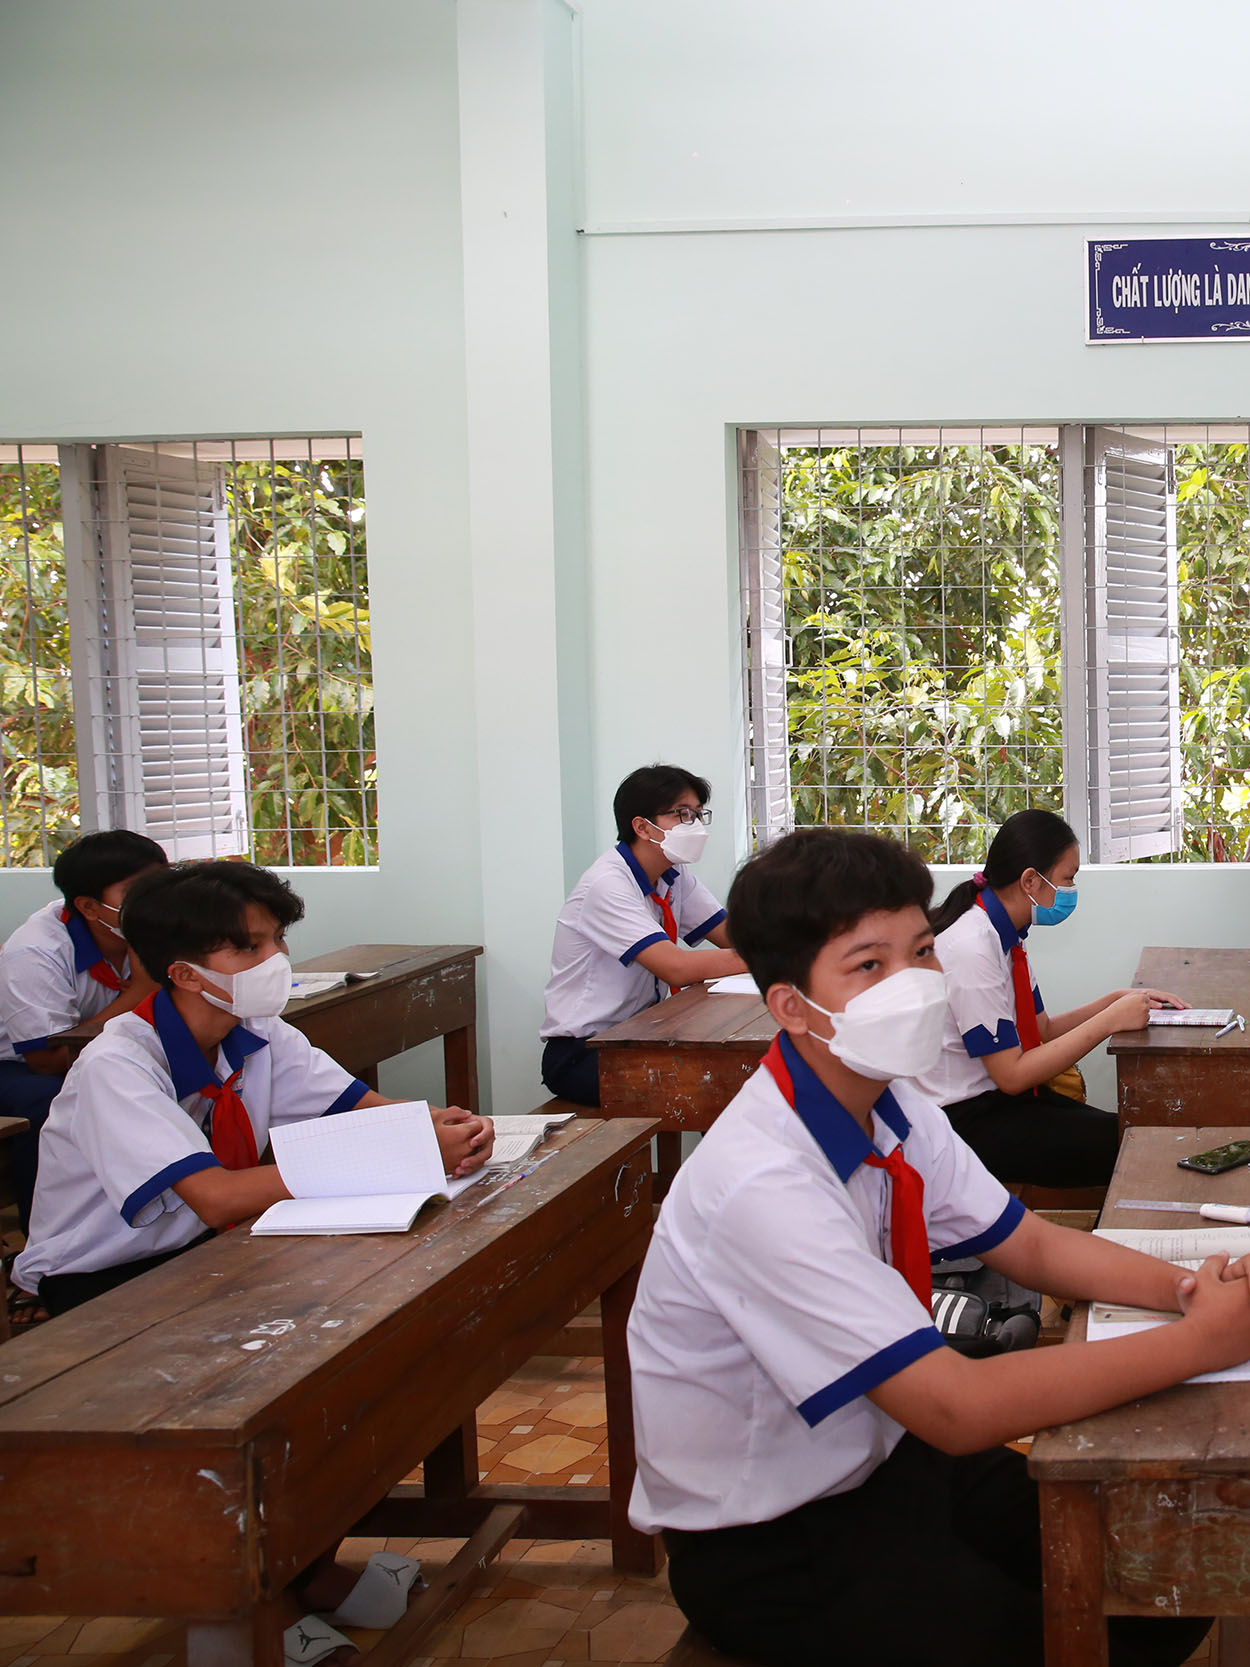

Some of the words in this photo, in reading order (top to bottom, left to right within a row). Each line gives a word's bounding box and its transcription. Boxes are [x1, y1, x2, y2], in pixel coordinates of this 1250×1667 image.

[1112, 262, 1149, 309] CHẤT
[1153, 267, 1201, 314] LƯỢNG
[1204, 264, 1223, 306] LÀ
